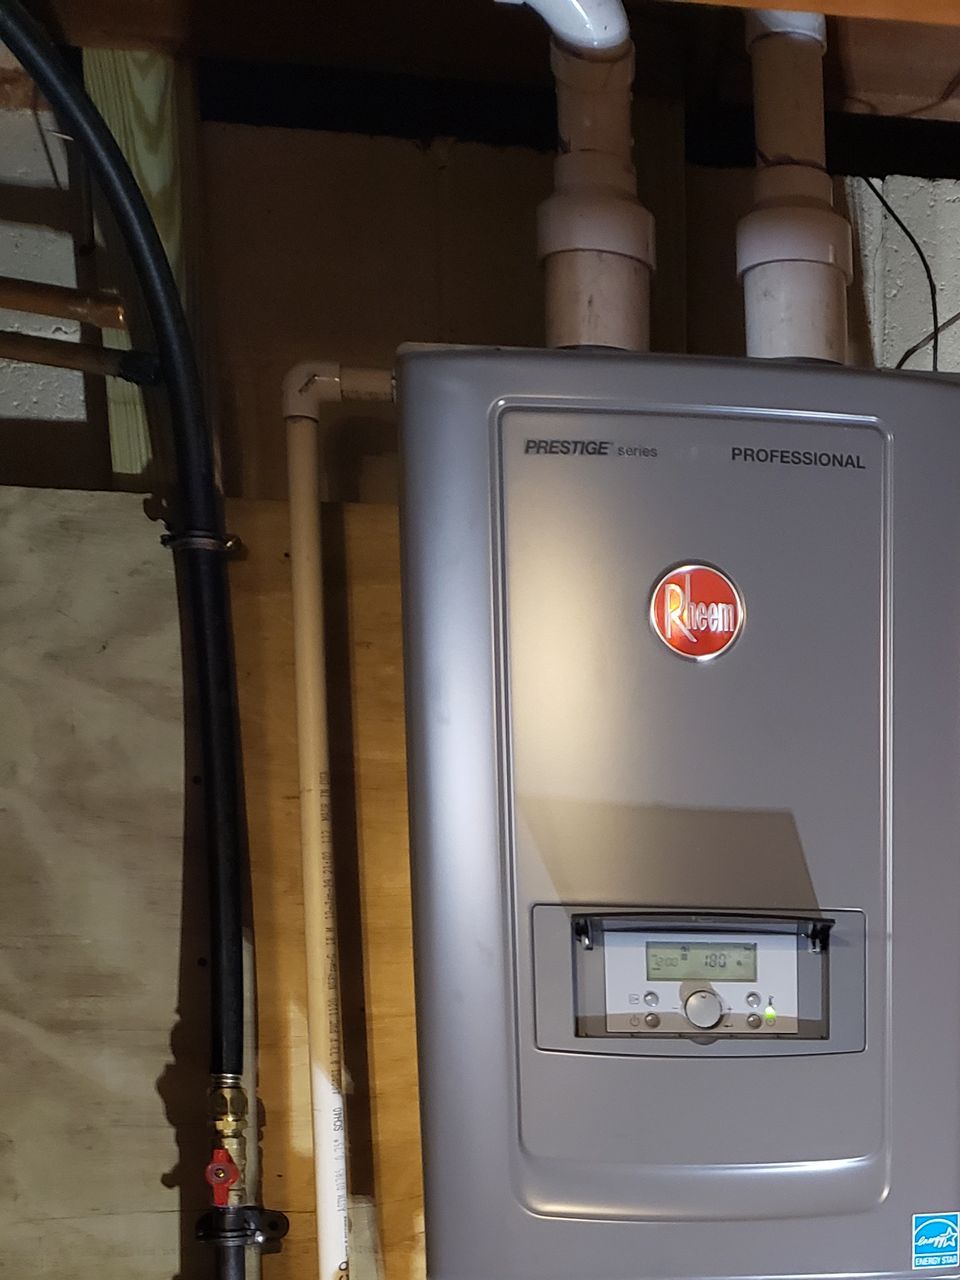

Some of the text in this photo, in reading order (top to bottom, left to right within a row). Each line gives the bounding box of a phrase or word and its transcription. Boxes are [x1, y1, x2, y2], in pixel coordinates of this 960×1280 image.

[524, 439, 658, 458] PRESTIGE series
[731, 447, 866, 470] PROFESSIONAL
[664, 573, 735, 642] Rheem
[332, 1106, 344, 1132] SCH40
[915, 1257, 941, 1266] ENERGY
